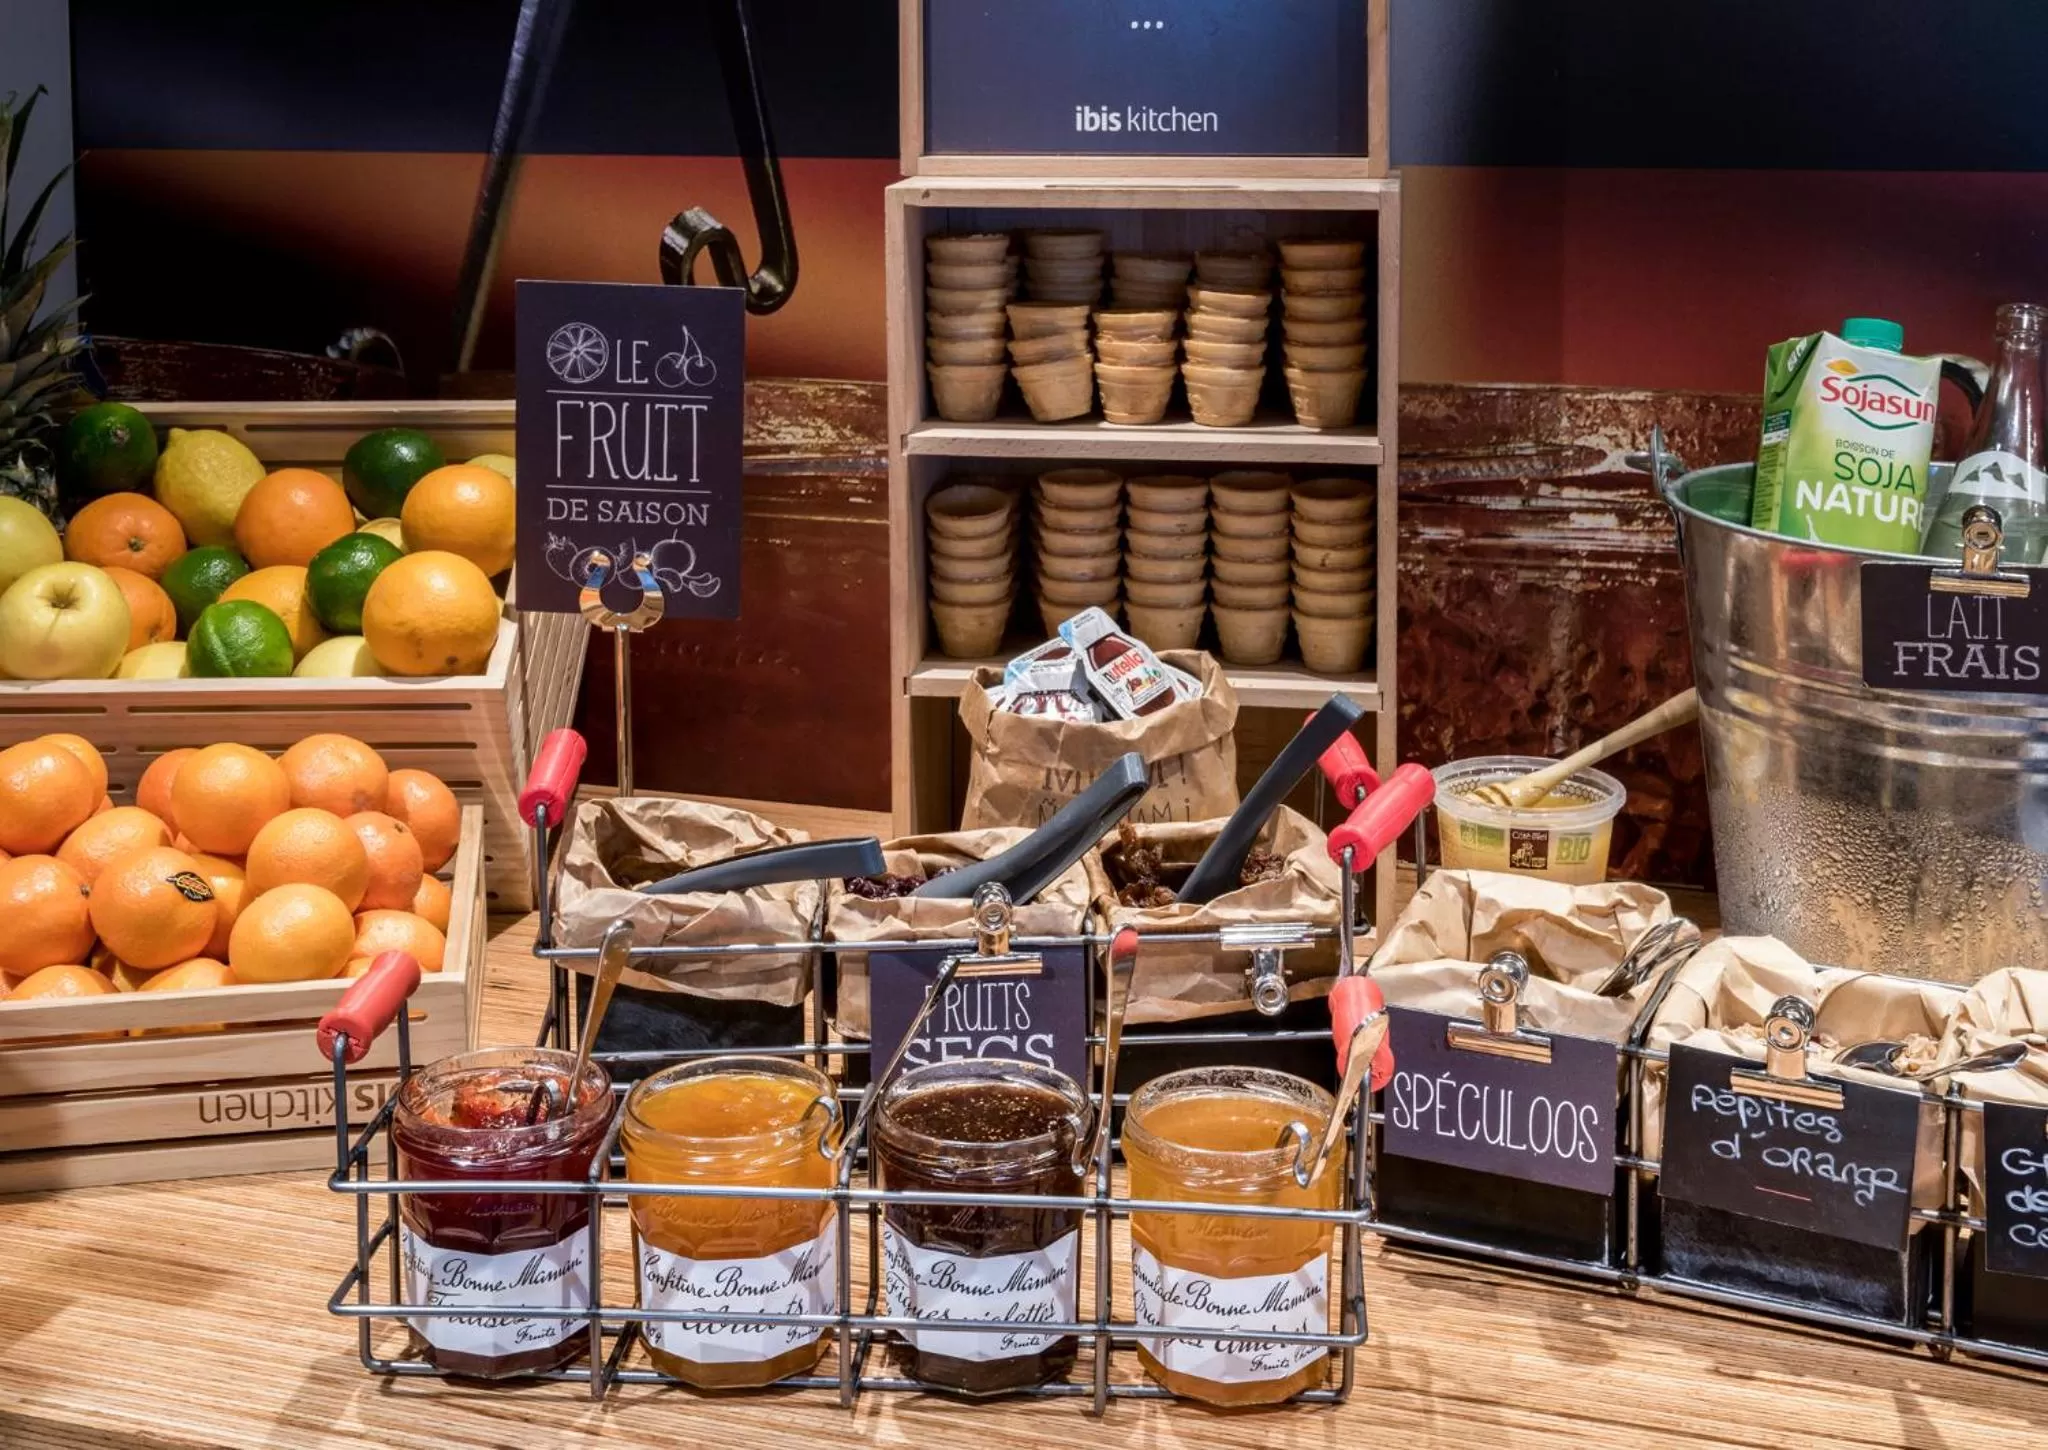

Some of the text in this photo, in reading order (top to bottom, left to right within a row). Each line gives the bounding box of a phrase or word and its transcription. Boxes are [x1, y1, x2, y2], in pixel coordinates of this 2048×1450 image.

[1075, 105, 1218, 132] ibis kitchen
[615, 339, 649, 384] LE
[1820, 376, 1936, 424] Sojasun
[556, 400, 709, 483] FRUIT
[1835, 439, 1896, 459] BOISSON DE
[1834, 451, 1916, 494] SOJA
[546, 497, 711, 527] DE SAISON
[1927, 594, 2007, 640] LAIT
[1103, 649, 1147, 686] nutella
[1893, 641, 2041, 681] FRAIS
[1555, 836, 1592, 862] BIO
[1393, 1071, 1598, 1164] SPÉCULOOS
[442, 1258, 507, 1293] Bonne
[642, 1252, 711, 1298] Confiture
[713, 1266, 781, 1298] Bonne
[928, 1259, 994, 1296] Bonne
[996, 1259, 1068, 1294] Maman
[1132, 1248, 1322, 1317] armelade Bonne Maman
